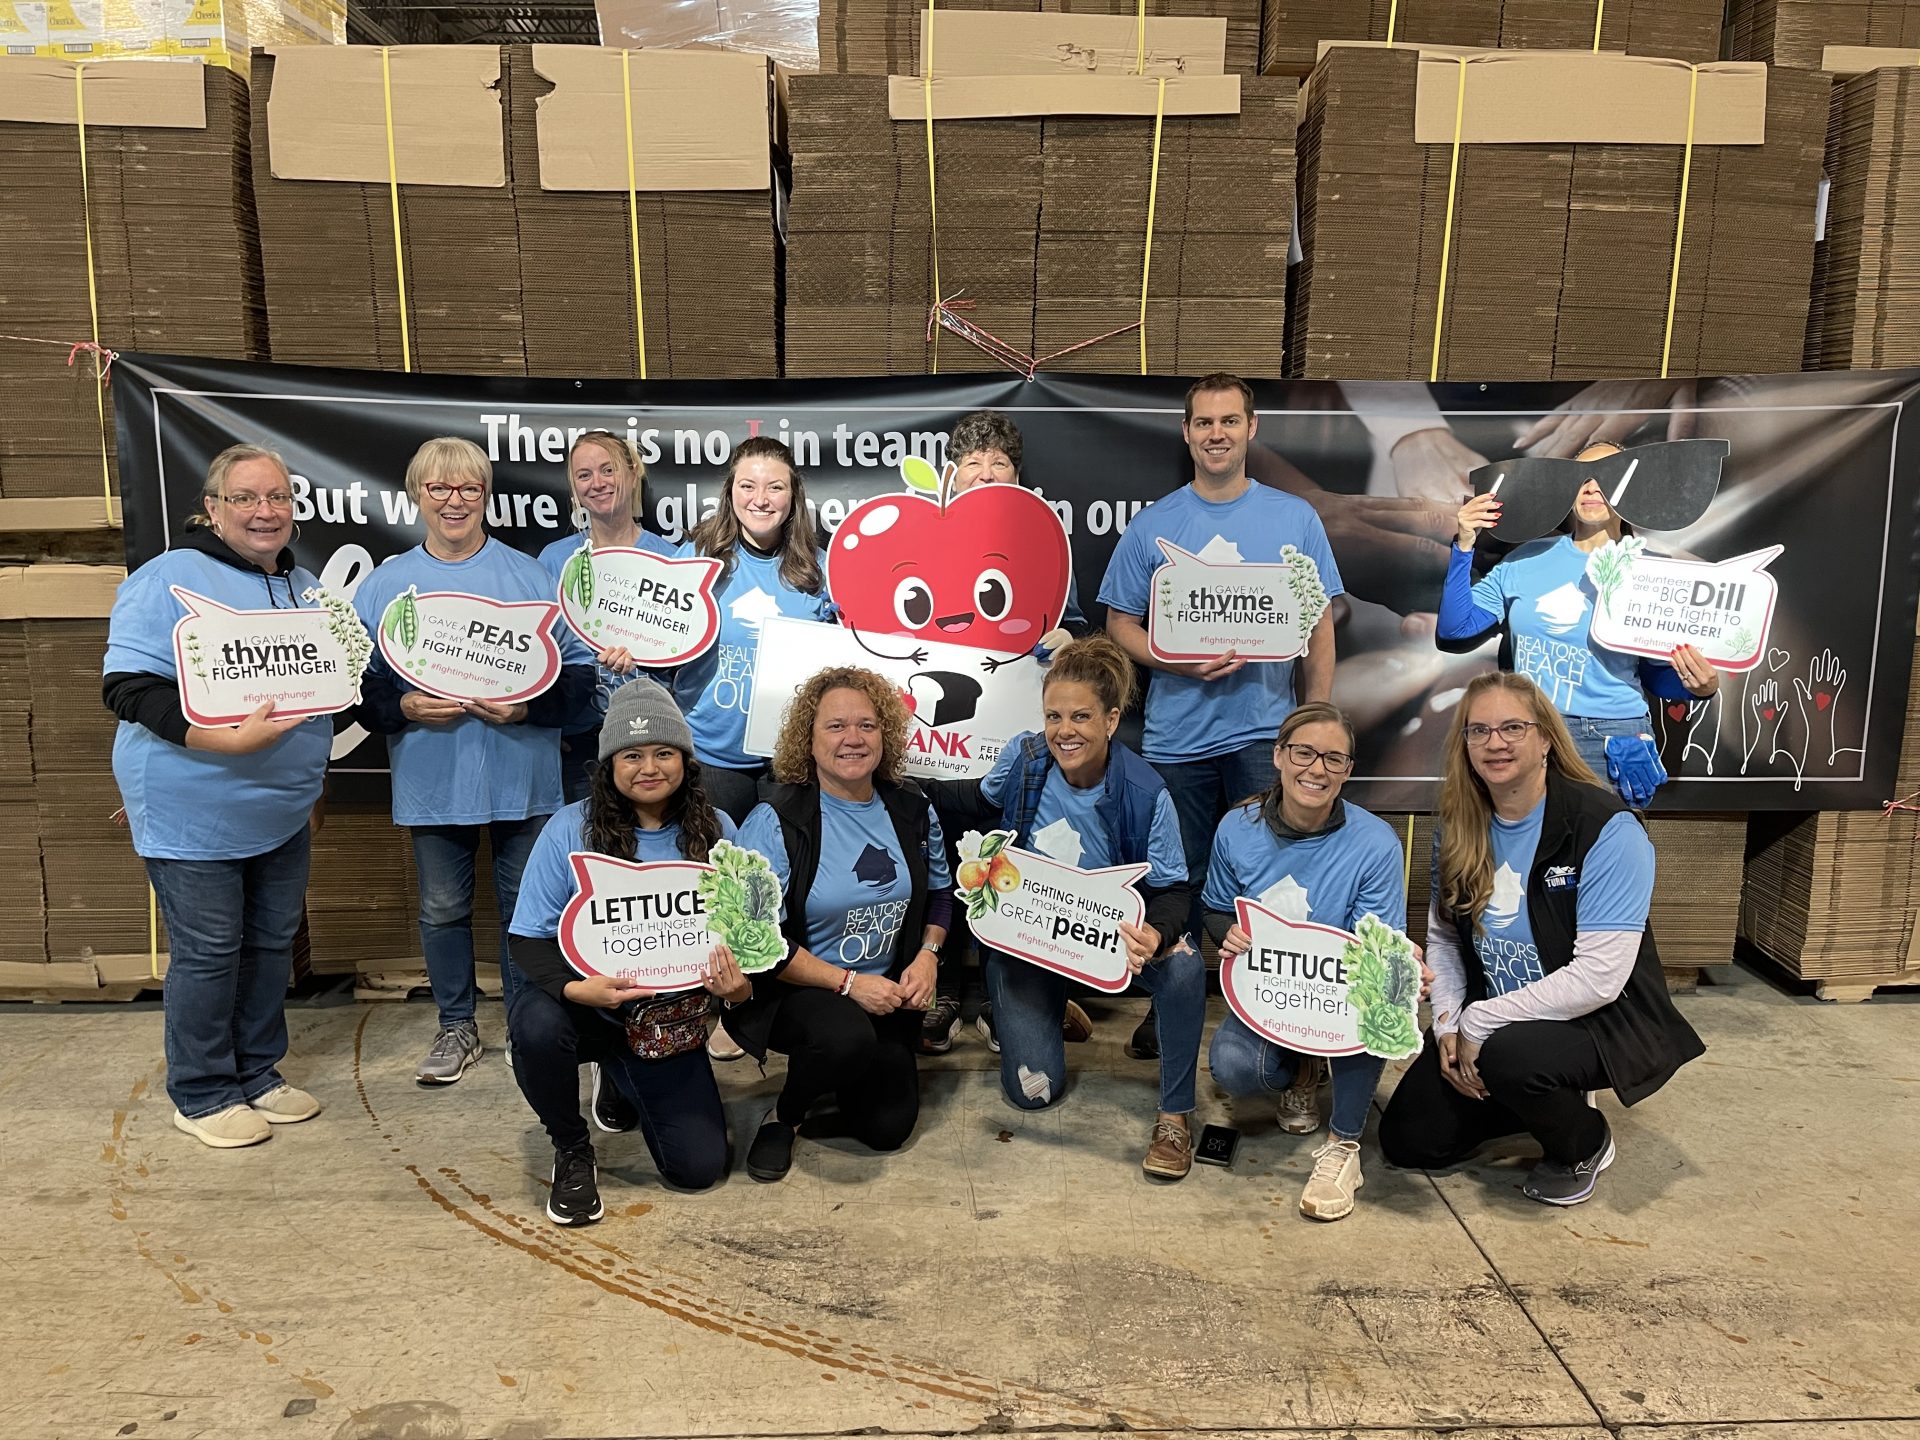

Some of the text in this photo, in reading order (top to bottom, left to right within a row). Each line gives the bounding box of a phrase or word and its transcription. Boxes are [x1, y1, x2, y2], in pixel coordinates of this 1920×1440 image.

[480, 414, 950, 467] Ther is no in team
[289, 474, 369, 525] But
[486, 493, 559, 529] ure
[603, 573, 630, 588] GAVE
[631, 582, 638, 590] A
[638, 578, 695, 612] PEAS
[1215, 585, 1247, 594] GAVE
[1249, 586, 1266, 594] MY
[1632, 574, 1692, 588] volunteers
[608, 589, 672, 615] OF MY TIME TO
[1180, 587, 1274, 616] to thyme
[1632, 580, 1747, 612] are a BIG Dill
[598, 598, 690, 635] FIGHT HUNGER!
[1177, 610, 1289, 625] FIGHT HUNGER!
[1627, 599, 1741, 626] in the fight to
[251, 634, 286, 646] GAVE
[289, 633, 307, 644] MY
[428, 616, 459, 630] GAVE
[459, 624, 467, 633] A
[467, 620, 532, 653] PEAS
[606, 623, 667, 647] #fightinghunger
[1623, 615, 1722, 639] END HUNGER!
[213, 639, 318, 670] to thyme
[434, 630, 506, 655] OF MY TIME TO
[1200, 636, 1265, 647] #fightinghunger
[212, 660, 337, 680] FIGHT HUNGER!
[422, 639, 527, 675] FIGHT HUNGER!
[1517, 649, 1586, 684] REACH
[431, 663, 500, 686] #fightinghunger
[243, 690, 316, 704] #fightinghunger
[906, 727, 974, 759] ANK
[924, 757, 937, 767] Be
[938, 760, 970, 774] Hungry
[590, 890, 708, 925] LETTUCE
[846, 898, 911, 923] REALTORS
[1022, 879, 1125, 922] FIGHTING HUNGER
[1031, 898, 1101, 928] makes us a
[611, 918, 697, 936] FIGHT HUNGER
[843, 910, 906, 936] REACH
[1000, 902, 1120, 954] GREAT pear!
[602, 929, 710, 957] together!
[839, 929, 901, 964] OUT
[1017, 931, 1085, 961] #fightinghunger
[1473, 934, 1539, 961] EALTORS
[616, 962, 708, 979] #fightinghunger
[1247, 946, 1348, 985] LETTUCE
[1479, 951, 1544, 980] EACH
[1263, 975, 1338, 996] FIGHT HUNGER
[1254, 983, 1348, 1016] together!
[1262, 1018, 1345, 1043] #fightinghunger
